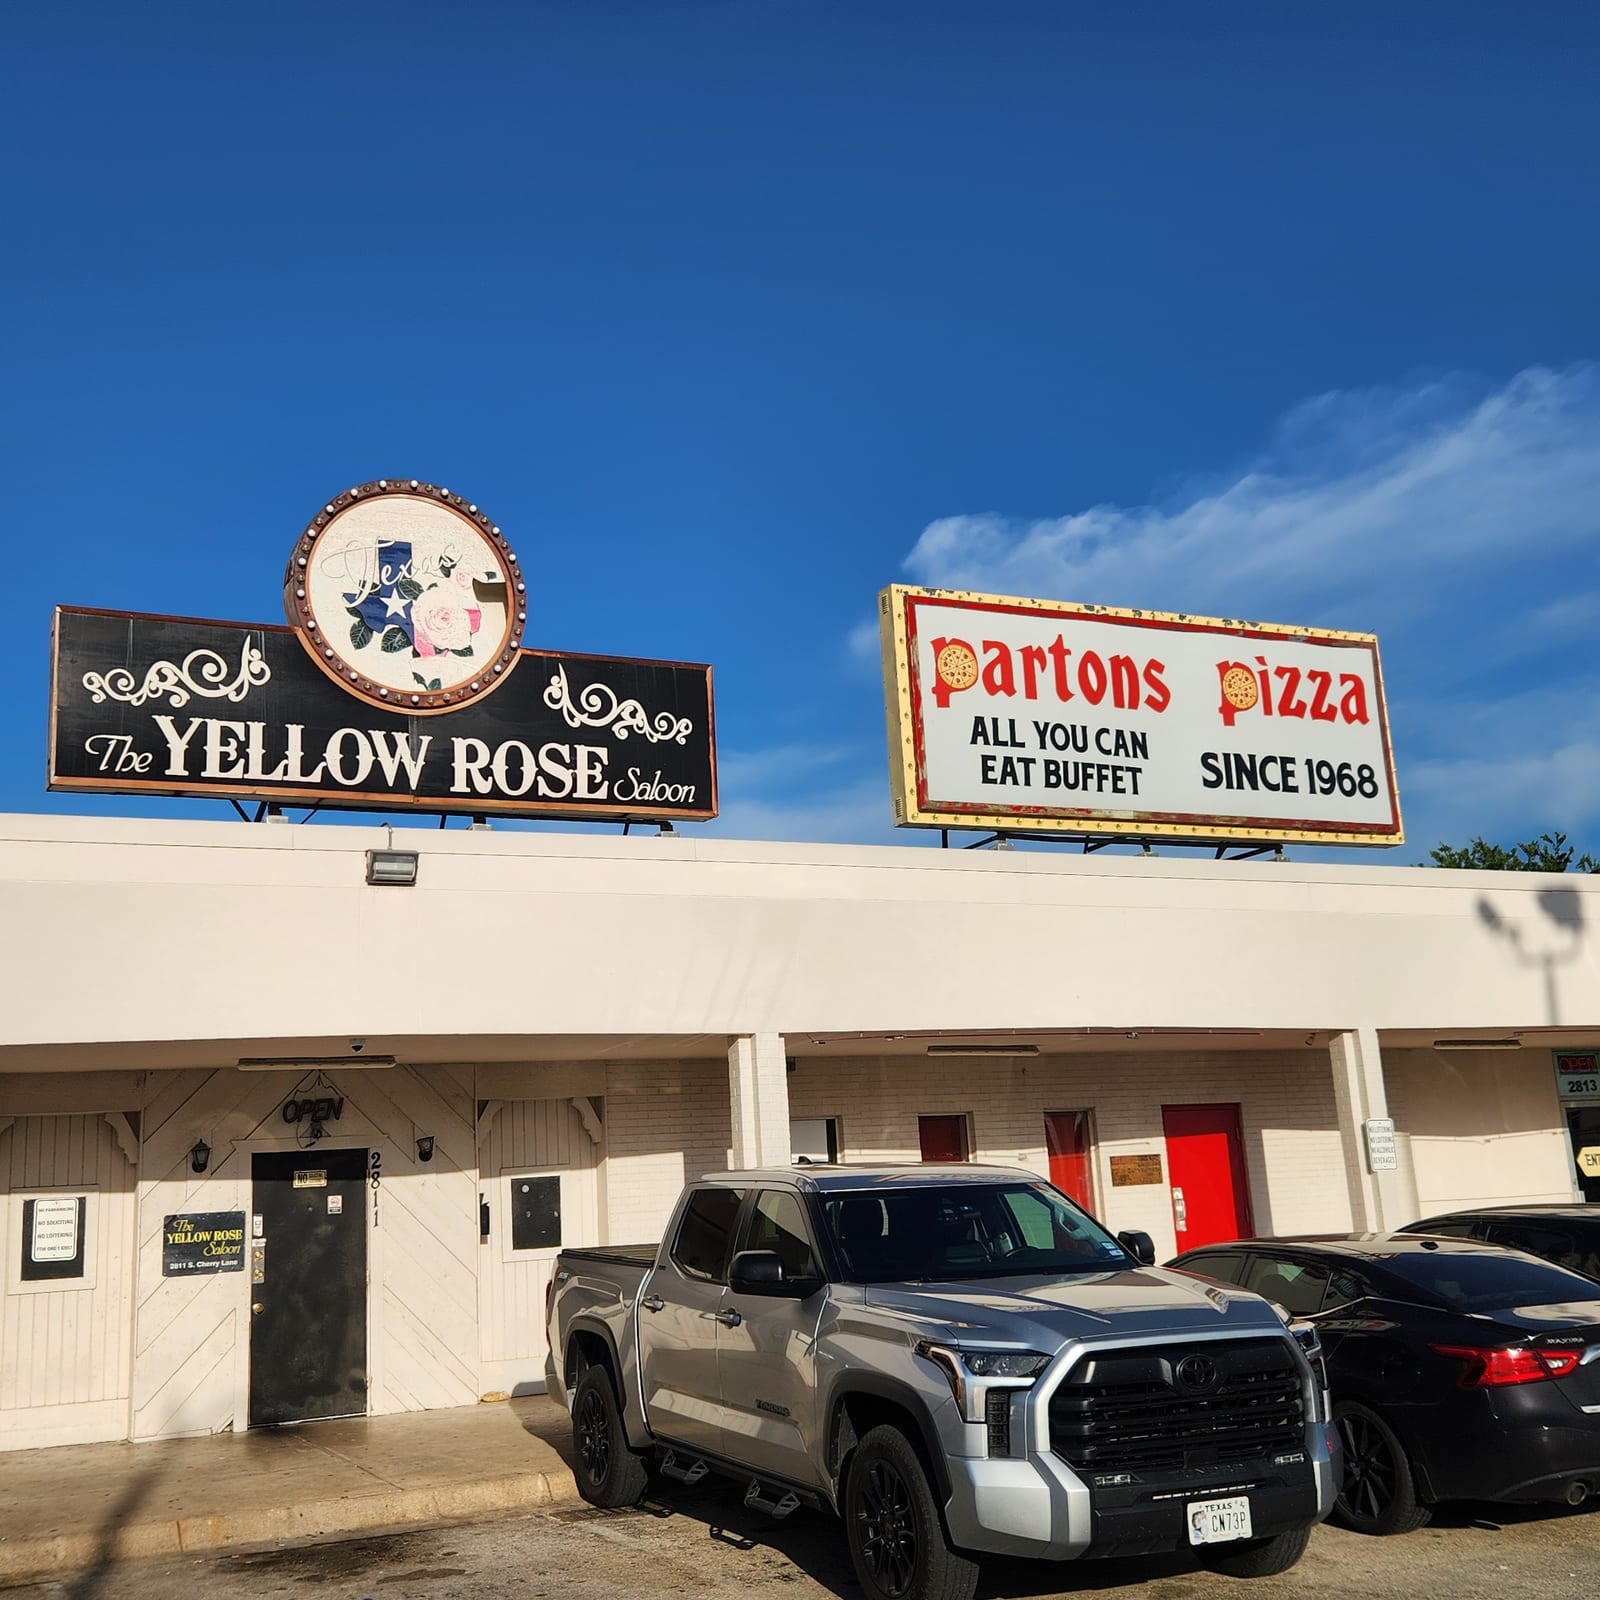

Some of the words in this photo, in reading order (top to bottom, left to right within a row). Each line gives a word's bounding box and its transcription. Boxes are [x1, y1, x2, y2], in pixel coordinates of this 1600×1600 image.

[320, 536, 463, 608] Texas
[930, 634, 1172, 712] partons
[1216, 656, 1370, 726] pizza
[970, 715, 1026, 748] ALL
[1032, 721, 1089, 753] YOU
[1095, 727, 1149, 760] CAN
[84, 733, 153, 774] The
[152, 714, 433, 792] YELLOW
[449, 736, 610, 800] ROSE
[613, 763, 696, 803] Saloon
[980, 754, 1037, 787] EAT
[1044, 758, 1143, 796] BUFFET
[1201, 752, 1300, 794] SINCE
[1304, 757, 1379, 798] 1968
[1560, 1056, 1597, 1074] OPEN
[1568, 1079, 1598, 1093] 2813
[282, 1097, 344, 1123] OPEN
[298, 1173, 307, 1184] NO
[371, 1152, 381, 1227] 2811
[173, 1219, 194, 1232] The
[167, 1231, 212, 1244] YELLOW
[214, 1229, 243, 1241] ROSE
[203, 1241, 241, 1256] Saloon
[170, 1262, 186, 1270] 2811
[196, 1260, 220, 1268] Cherry
[1205, 1503, 1233, 1512] TEXAS
[1212, 1511, 1246, 1532] CN73P
